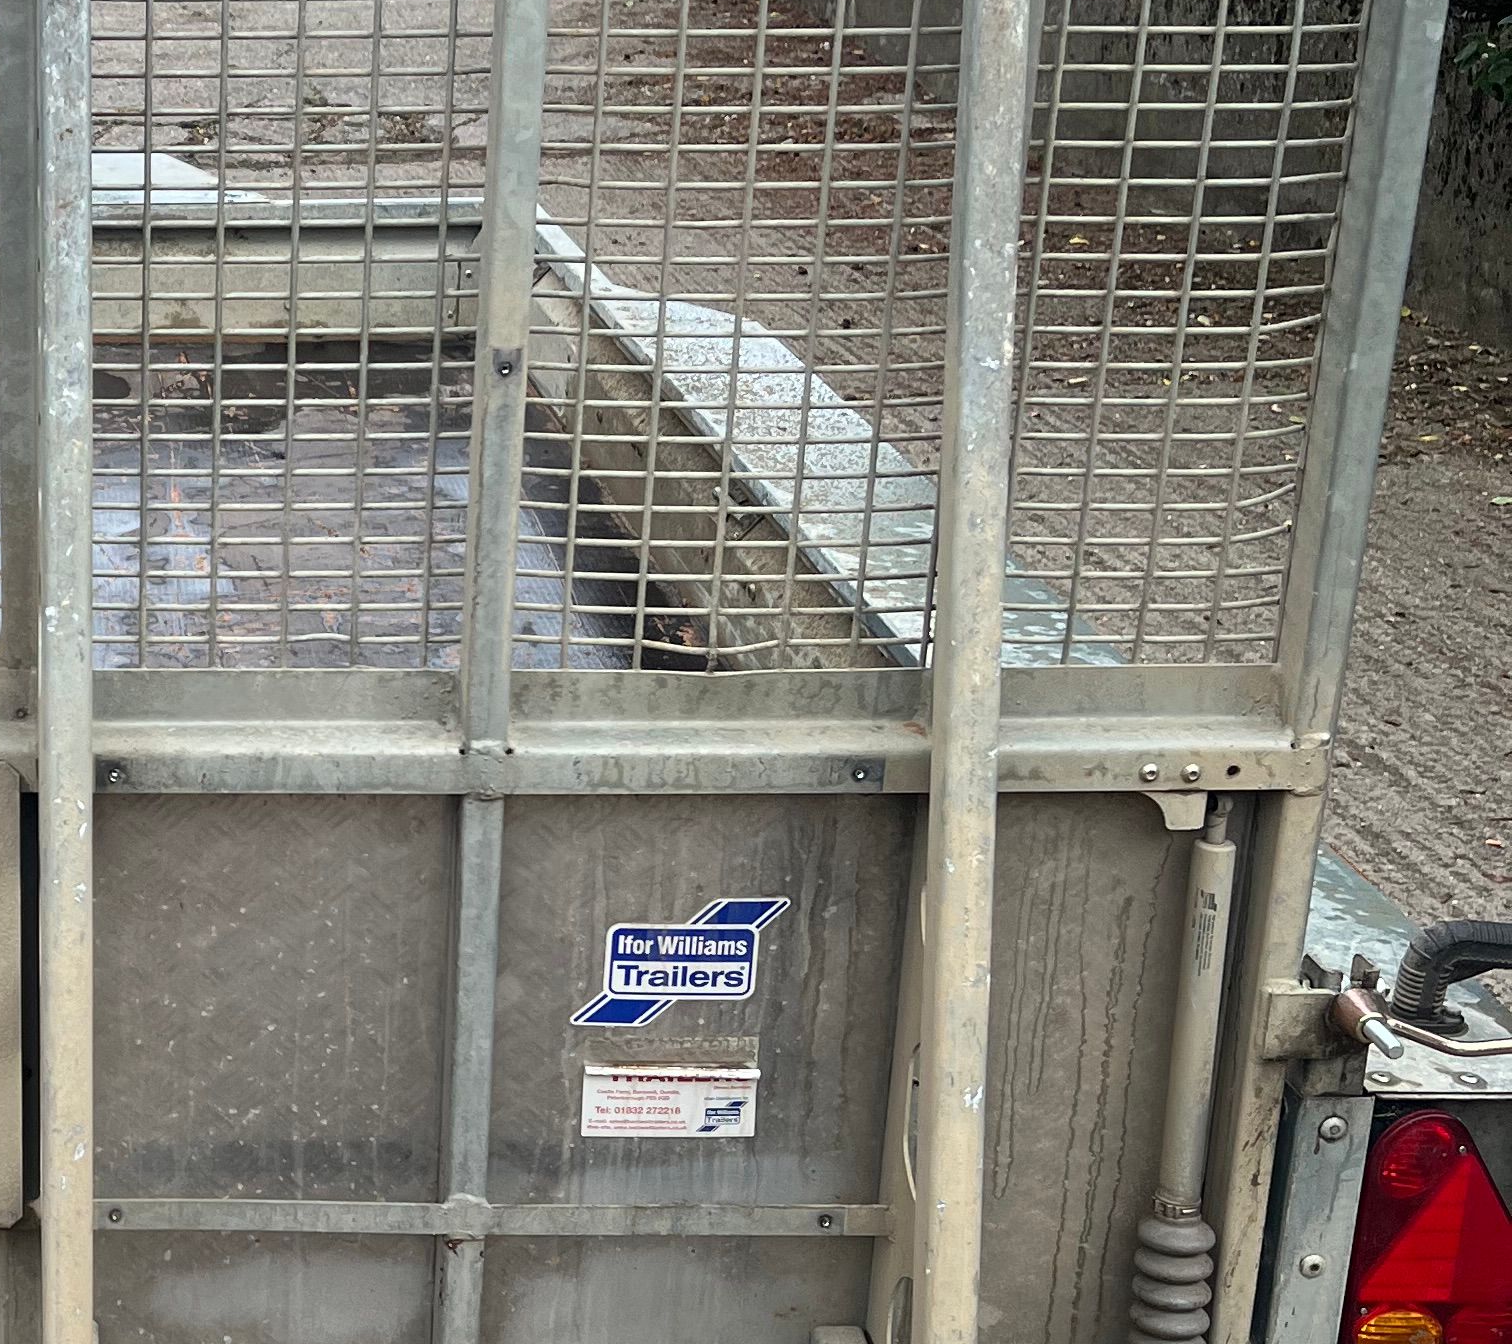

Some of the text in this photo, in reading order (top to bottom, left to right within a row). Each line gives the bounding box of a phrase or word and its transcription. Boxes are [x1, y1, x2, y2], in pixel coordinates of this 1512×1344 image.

[617, 935, 748, 956] Ifor Williams
[617, 964, 745, 988] Trailers
[595, 1106, 611, 1114] Tel:
